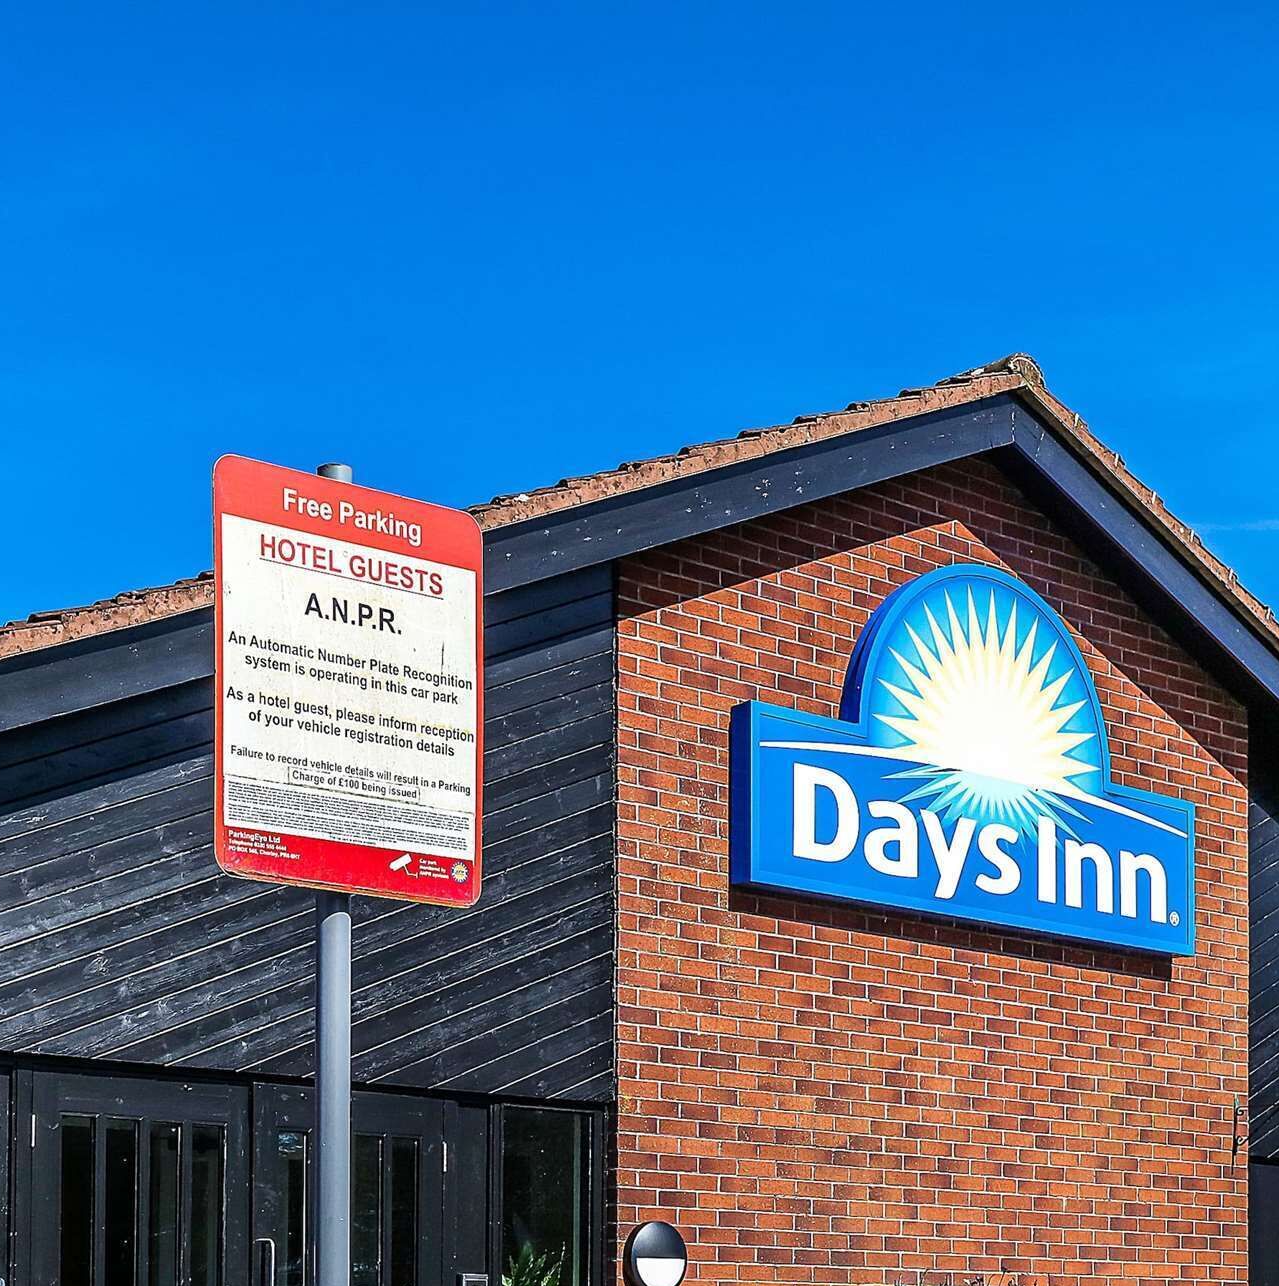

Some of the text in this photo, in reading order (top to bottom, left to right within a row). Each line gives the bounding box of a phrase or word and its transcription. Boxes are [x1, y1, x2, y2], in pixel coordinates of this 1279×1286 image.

[282, 487, 422, 547] Free Parking
[260, 533, 444, 596] HOTEL GUESTS
[304, 592, 402, 635] A.N.P.R.
[228, 630, 472, 690] An Automatic Number Plate Recognition
[245, 655, 458, 704] system is operating in this car park
[226, 686, 474, 743] As a hotel guest, please inform reception
[248, 710, 455, 756] of your vehicle registration details
[230, 744, 471, 796] Failure to record vehicle details will result in a Parking
[292, 770, 417, 799] Charge of £100 being issued
[792, 762, 1022, 900] Days
